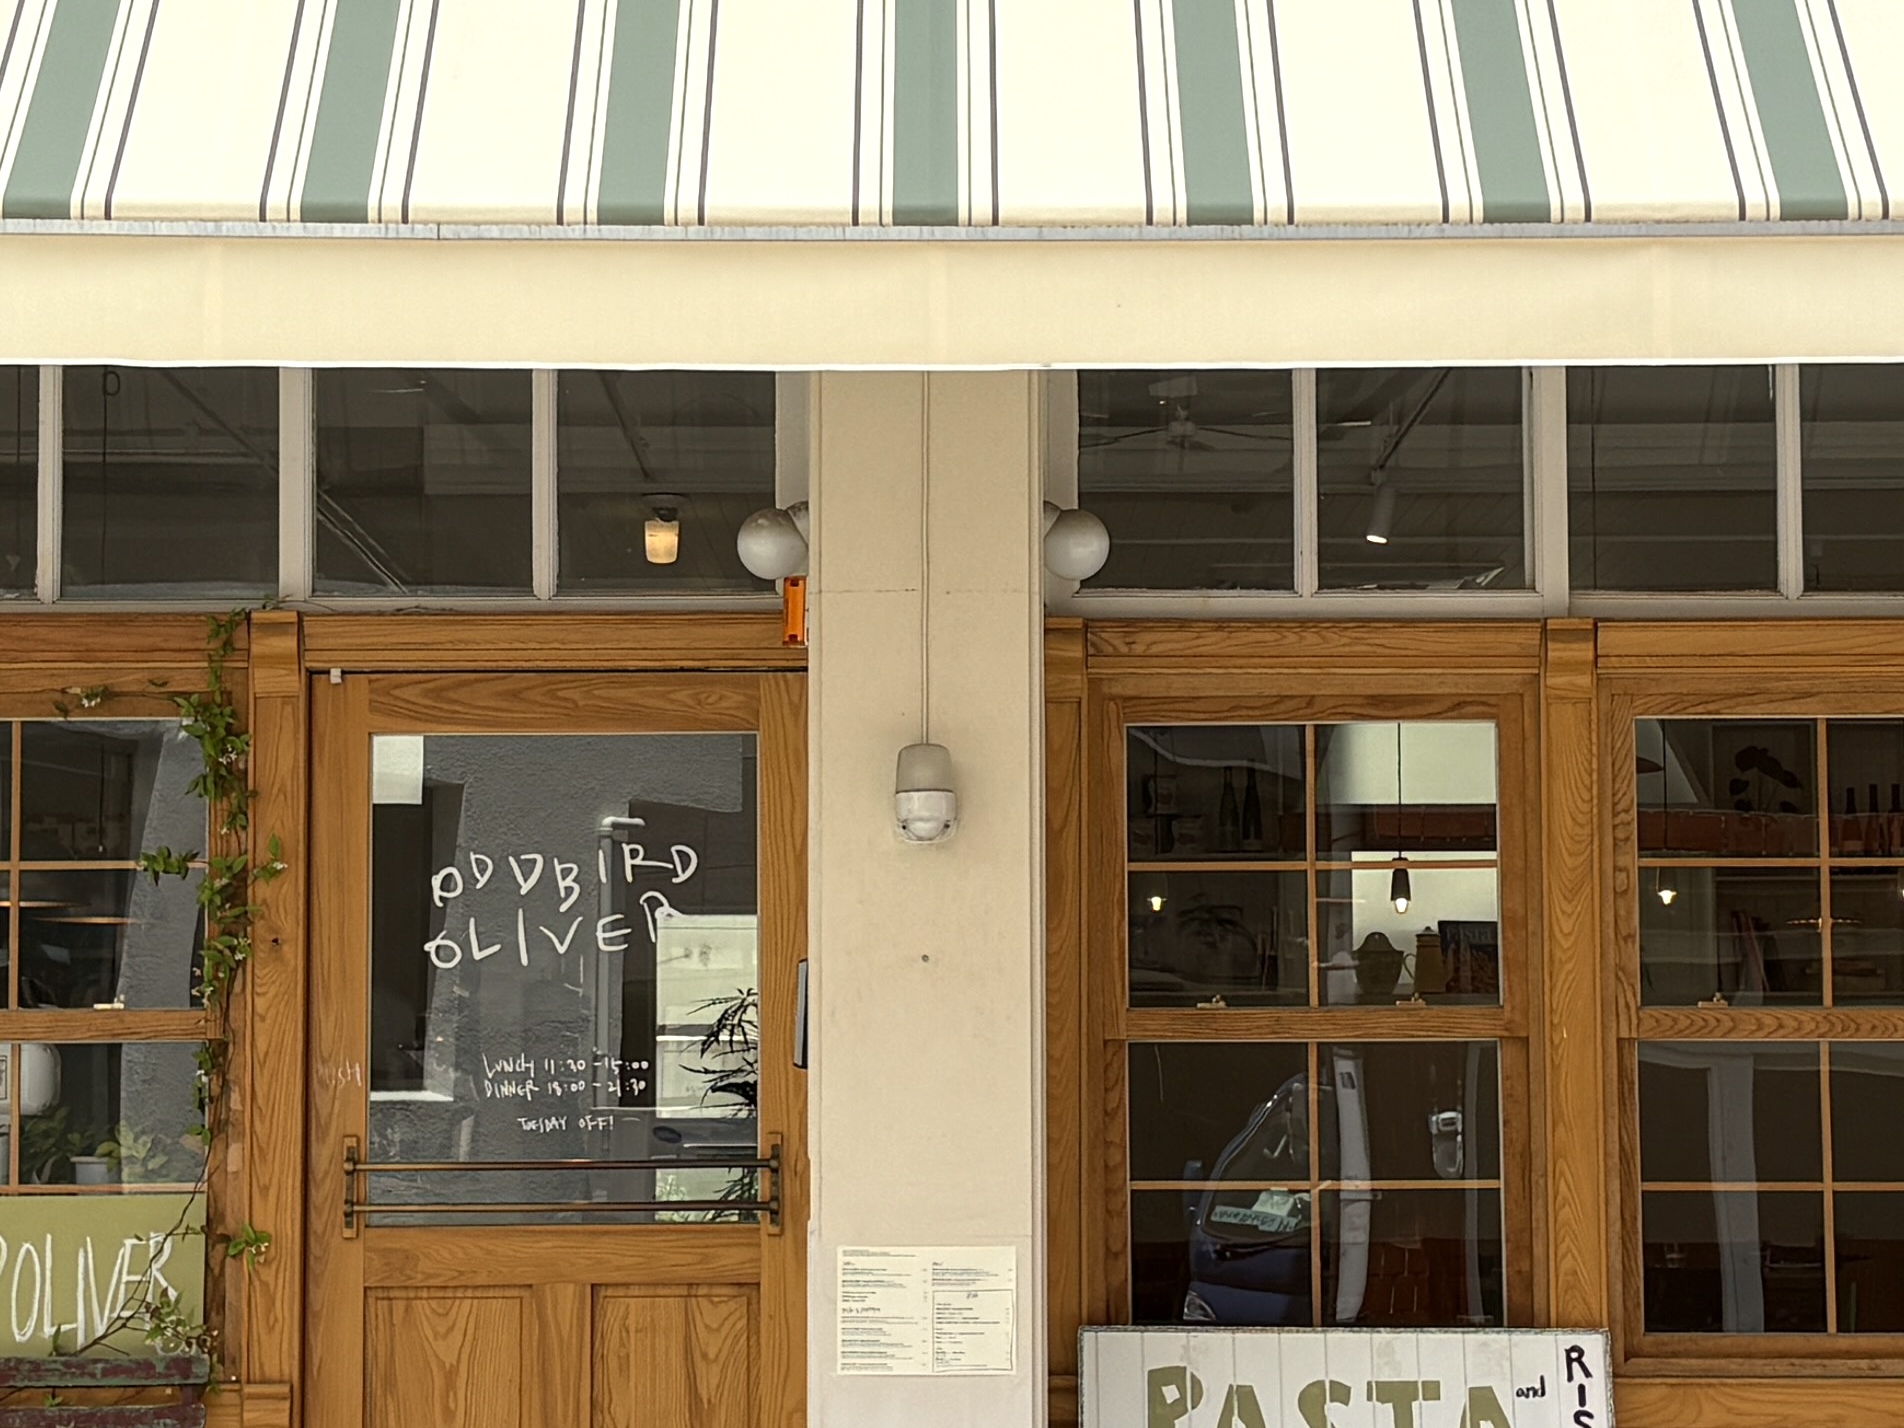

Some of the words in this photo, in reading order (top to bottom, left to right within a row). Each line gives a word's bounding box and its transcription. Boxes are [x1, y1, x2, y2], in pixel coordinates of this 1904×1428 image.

[423, 891, 682, 968] OLIVER
[482, 1052, 534, 1079] LUNCH
[484, 1079, 540, 1101] DINNER
[517, 1116, 567, 1133] TUESDAY
[579, 1115, 613, 1131] OFF!
[1516, 1376, 1546, 1400] and
